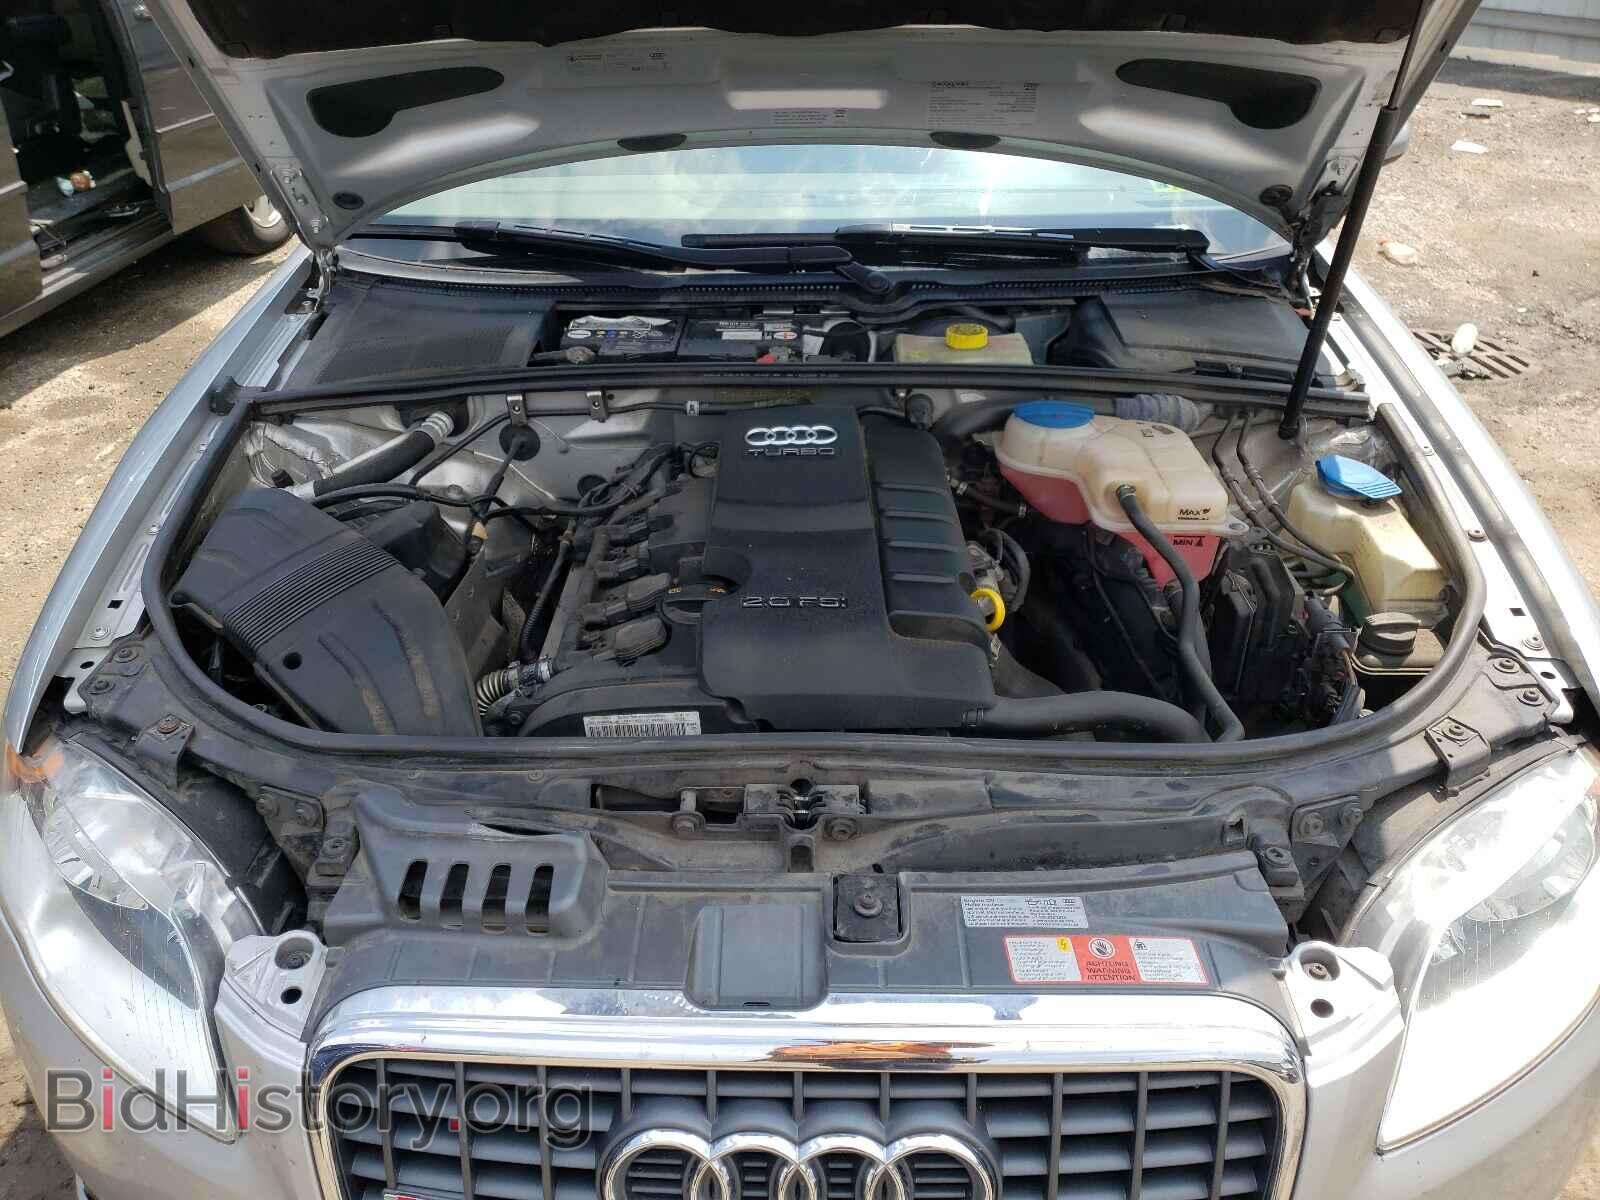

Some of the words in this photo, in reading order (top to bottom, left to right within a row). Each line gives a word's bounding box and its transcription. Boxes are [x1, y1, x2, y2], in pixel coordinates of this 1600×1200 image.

[747, 447, 835, 456] TURBO
[1179, 508, 1201, 516] MAX
[743, 596, 791, 607] 2.0
